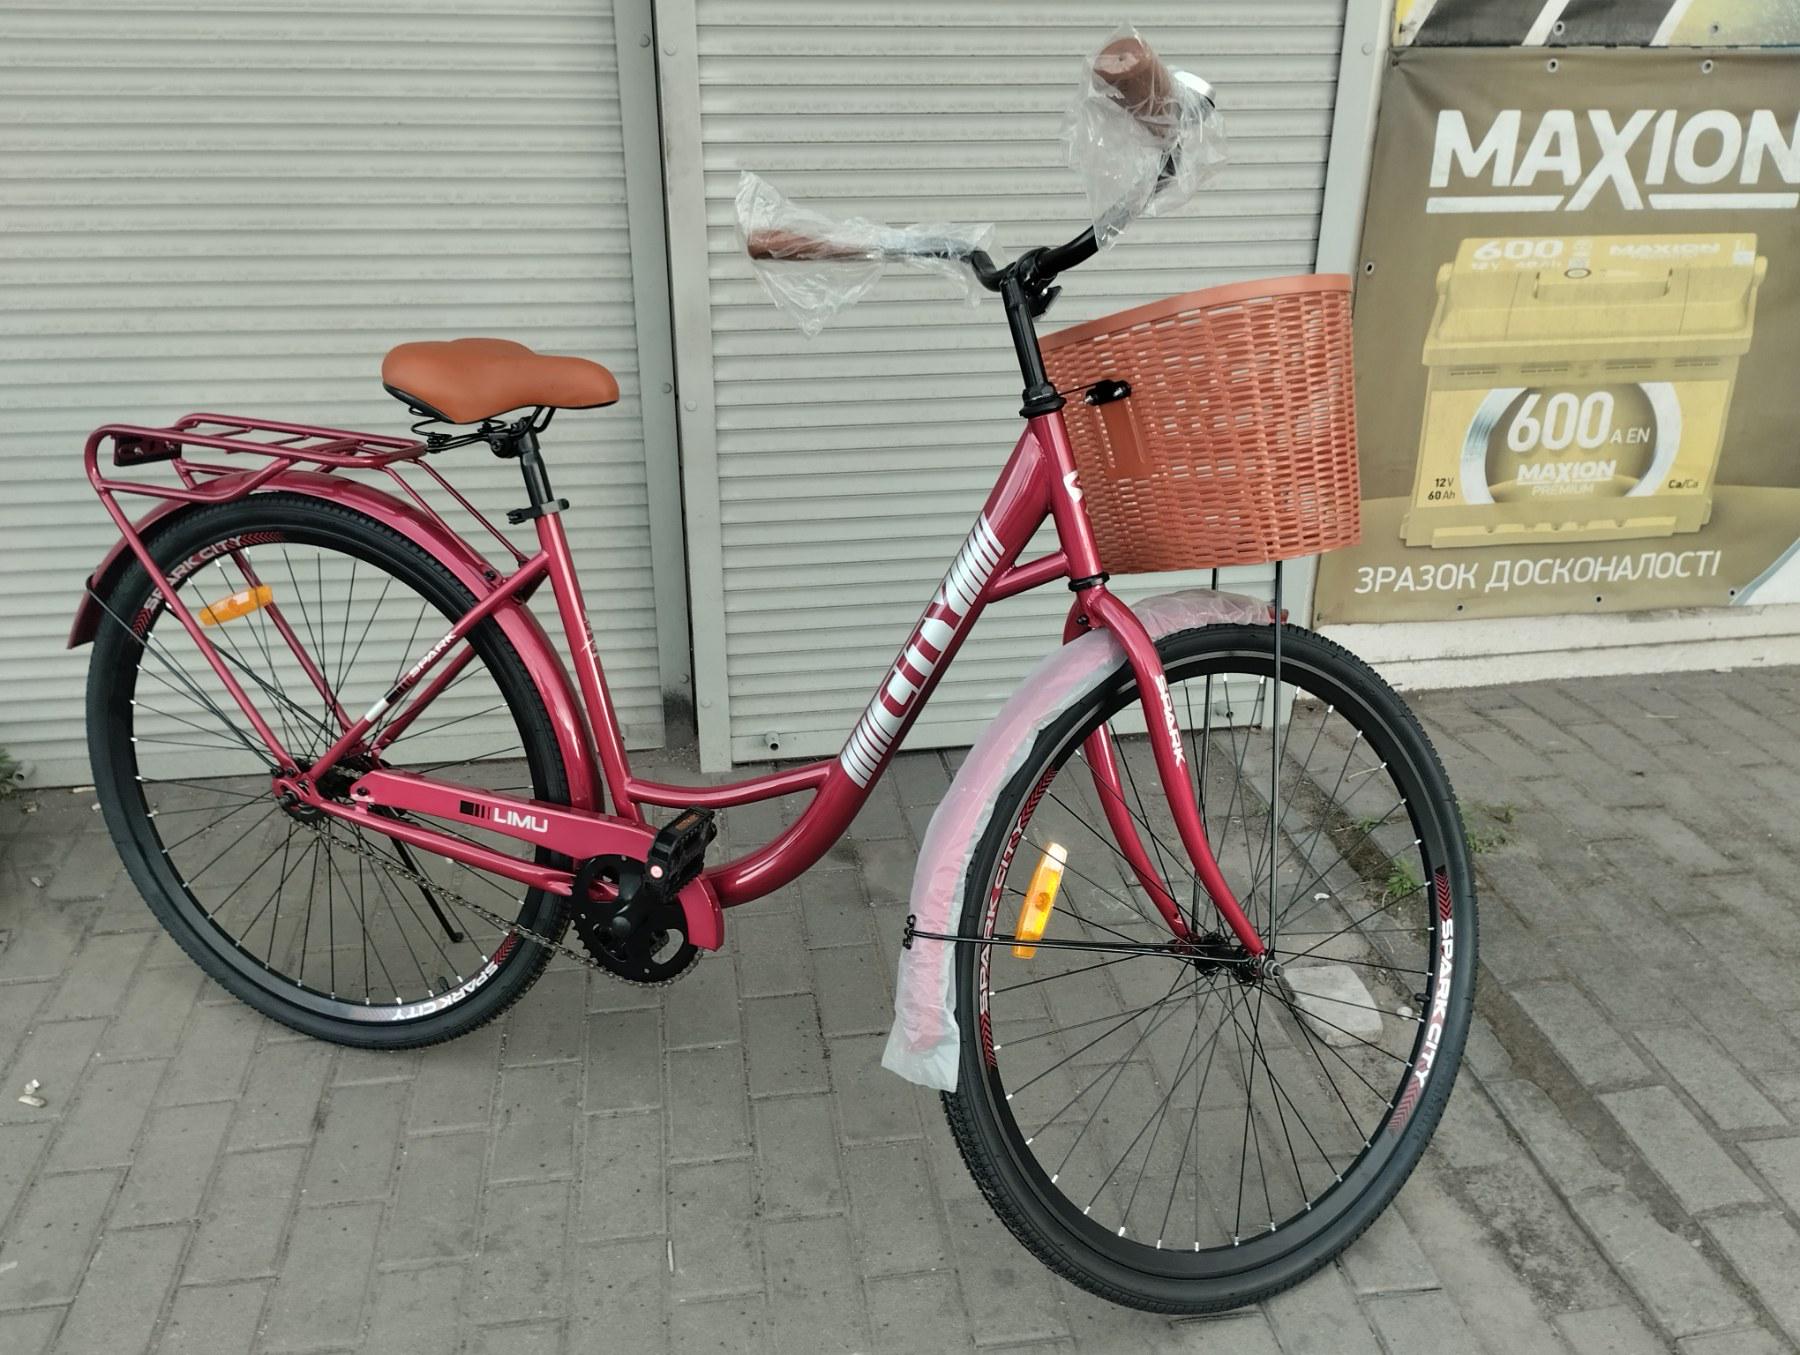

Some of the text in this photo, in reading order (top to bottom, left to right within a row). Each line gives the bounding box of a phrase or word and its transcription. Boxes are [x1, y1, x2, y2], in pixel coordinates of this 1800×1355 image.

[1429, 108, 1800, 211] MAXION
[1473, 239, 1564, 261] 600
[1507, 391, 1650, 453] 600 A EN
[1517, 460, 1617, 483] MAXION
[1531, 483, 1594, 497] PREMIUM
[200, 535, 242, 560] CITY
[1354, 550, 1722, 594] ЗРАЗОК ДОСКОНАЛОСТІ
[409, 631, 457, 678] SPARK
[879, 580, 964, 718] CITY
[1154, 674, 1186, 769] SPARK
[493, 807, 548, 833] LIMU
[979, 815, 1024, 1016] SPARK CITY
[391, 960, 499, 1021] SPARK CITY
[1431, 918, 1454, 1021] SPARK
[1414, 1022, 1443, 1088] CITY
